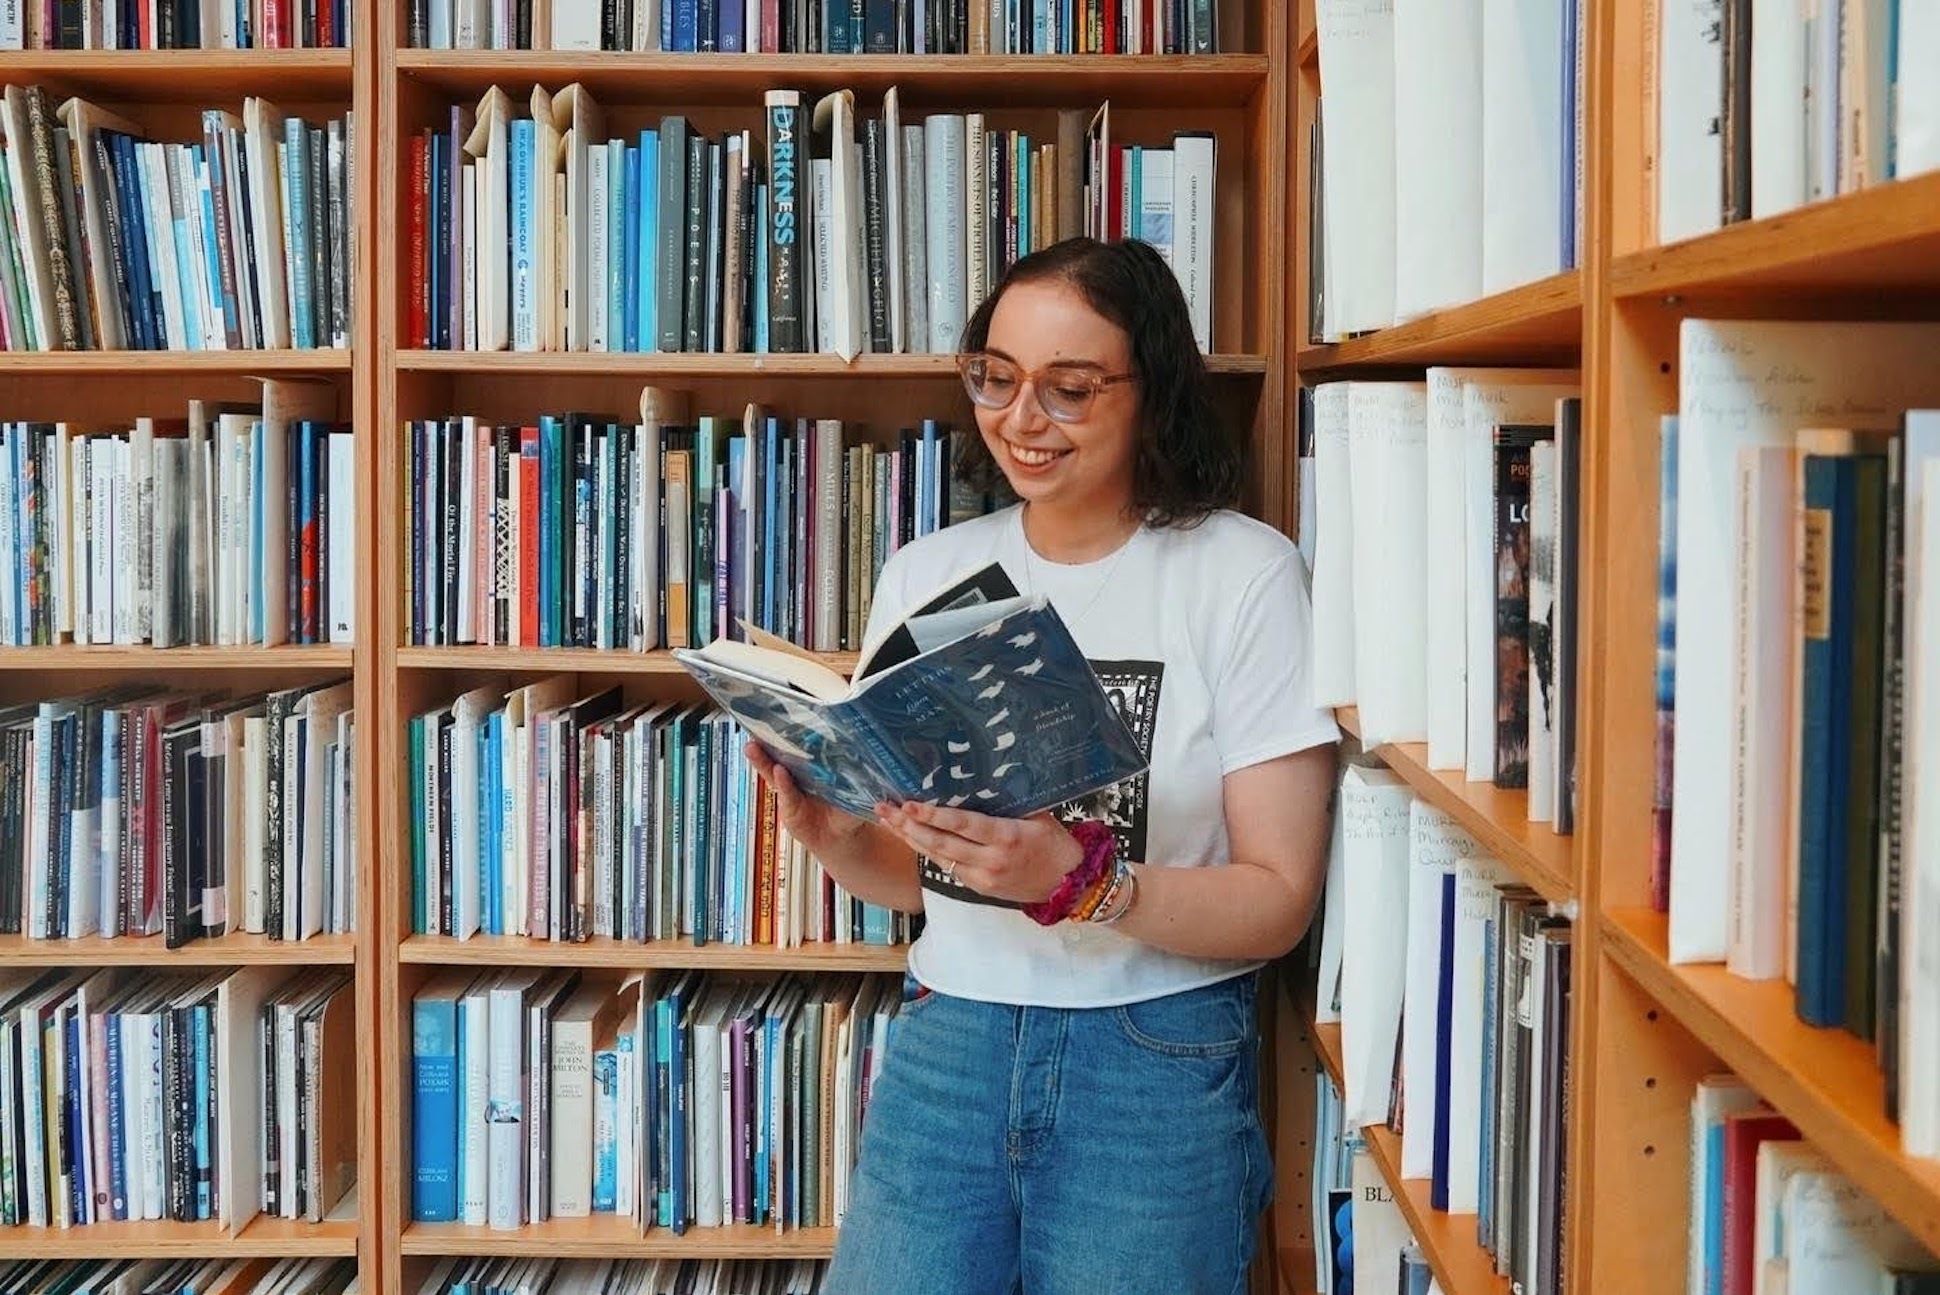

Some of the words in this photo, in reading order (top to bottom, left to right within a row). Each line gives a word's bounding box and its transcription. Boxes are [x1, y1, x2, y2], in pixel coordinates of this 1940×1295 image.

[772, 107, 795, 245] DARKNESS
[972, 150, 982, 201] SONNETS
[518, 202, 527, 253] RAINCOAT
[690, 207, 700, 283] POEMS
[946, 217, 957, 304] MICHELANGELO
[869, 206, 884, 328] MICHELANGELO
[825, 472, 836, 511] MILES
[447, 518, 456, 532] the
[447, 535, 456, 564] Mortal
[1149, 675, 1158, 691] THE
[1145, 691, 1156, 722] POETRY
[76, 719, 84, 752] ROAD
[1140, 722, 1151, 755] SOCIETY
[165, 778, 173, 801] Letter
[1136, 787, 1144, 810] YORK
[165, 803, 172, 811] to
[164, 825, 174, 865] Imaginary
[167, 867, 175, 893] Friend
[552, 1064, 588, 1073] MILTON
